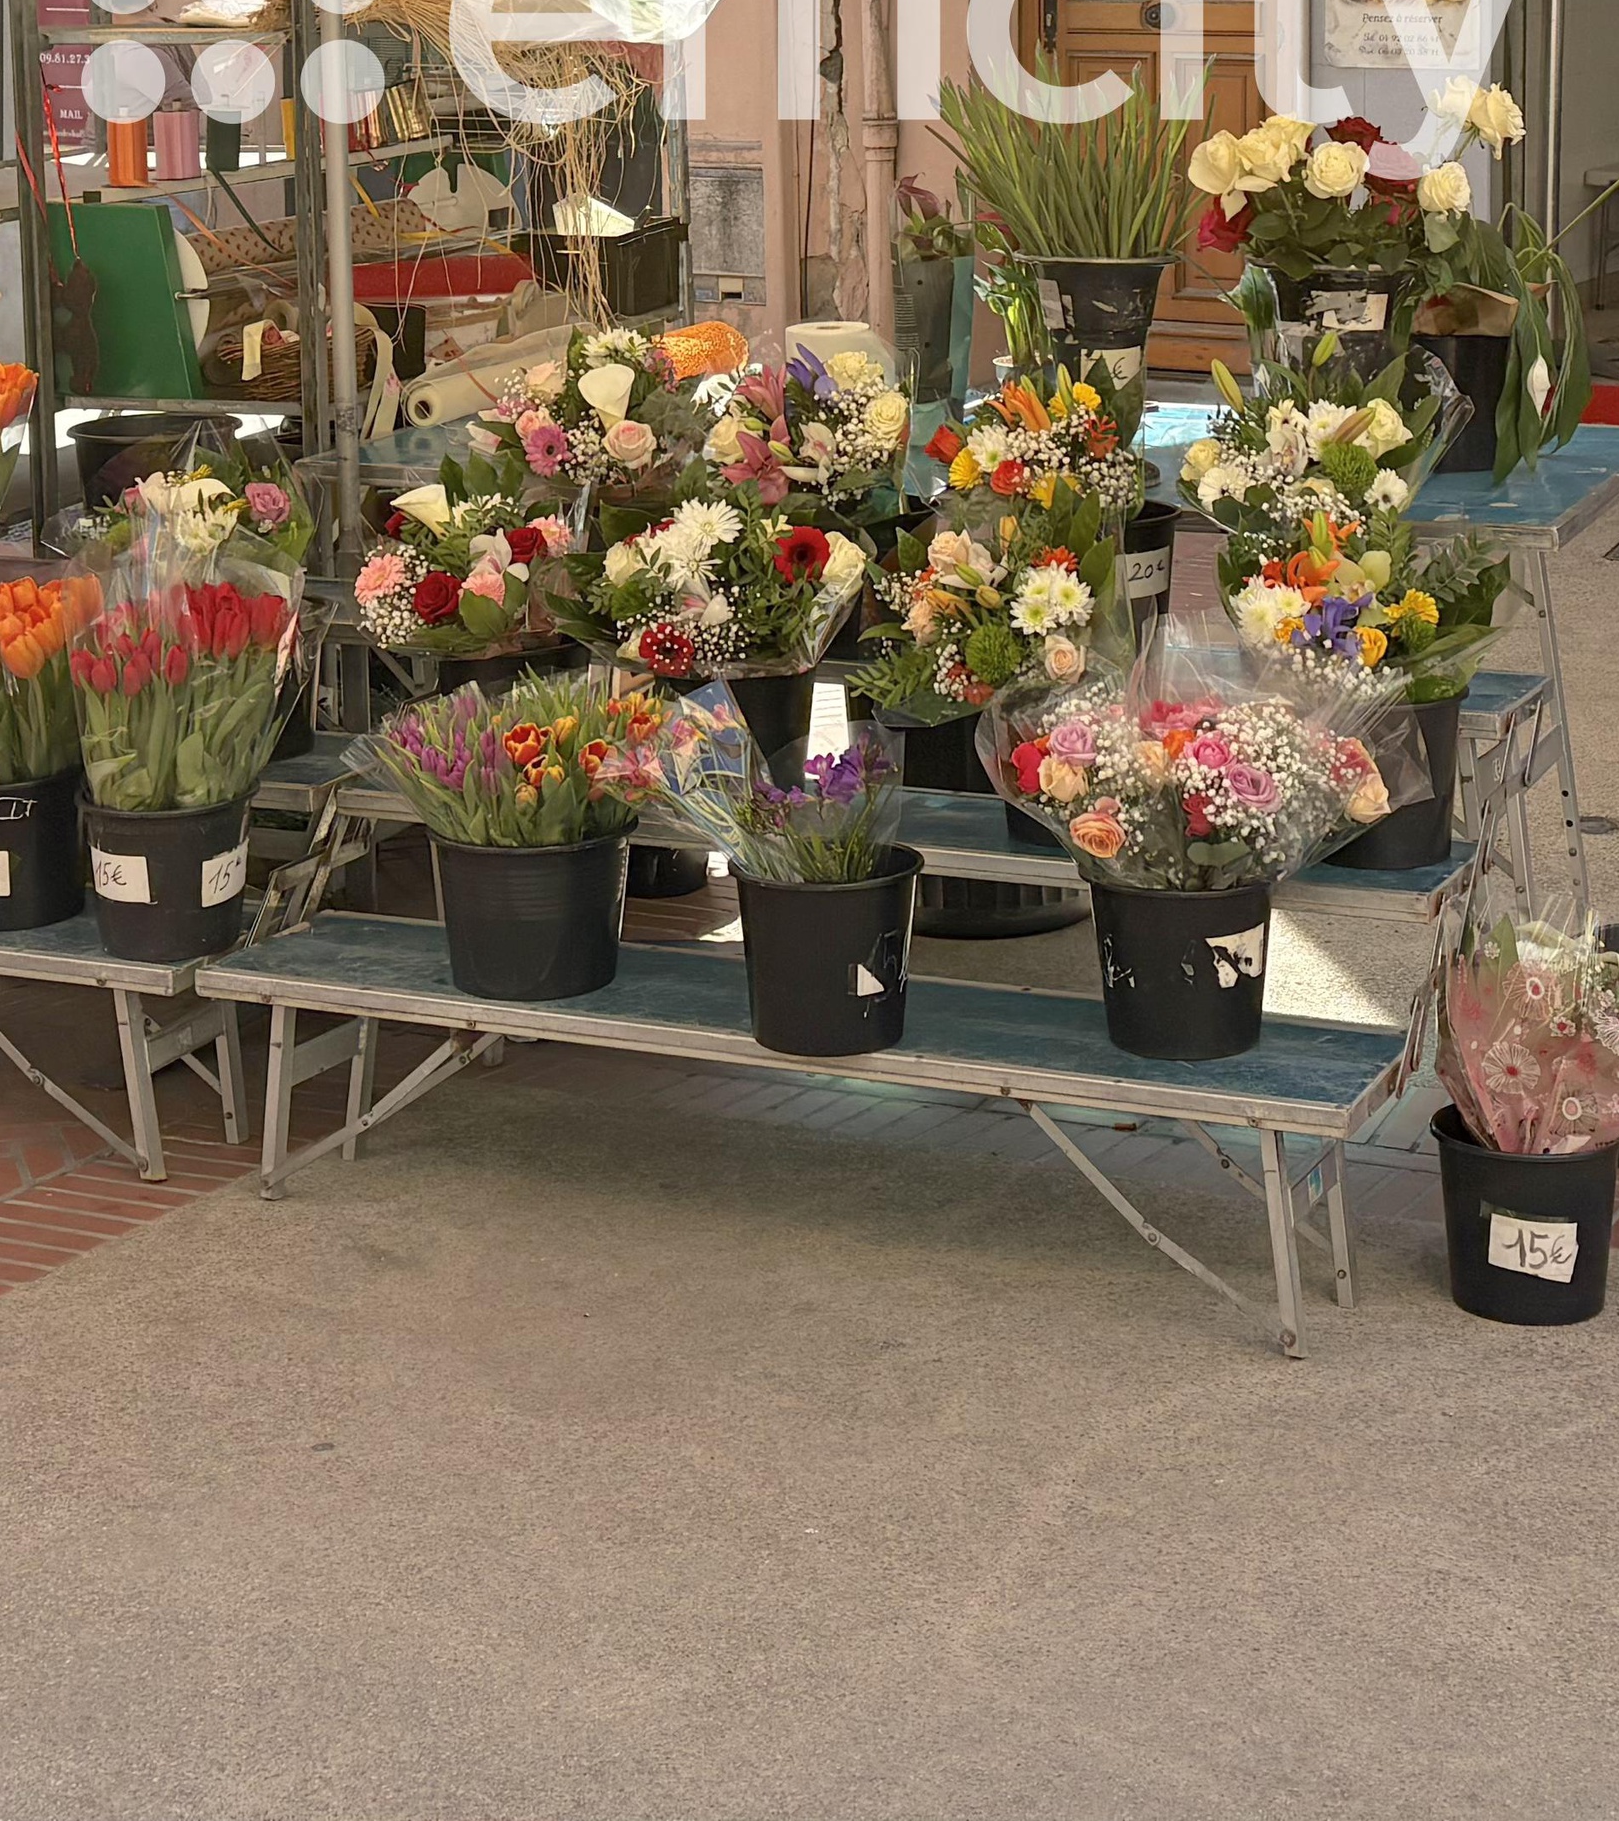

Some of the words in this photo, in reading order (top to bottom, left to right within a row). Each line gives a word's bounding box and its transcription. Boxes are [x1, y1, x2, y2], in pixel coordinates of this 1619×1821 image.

[39, 53, 90, 65] 09.81.27.3
[95, 860, 127, 887] 15€
[1502, 1228, 1572, 1269] 15€
